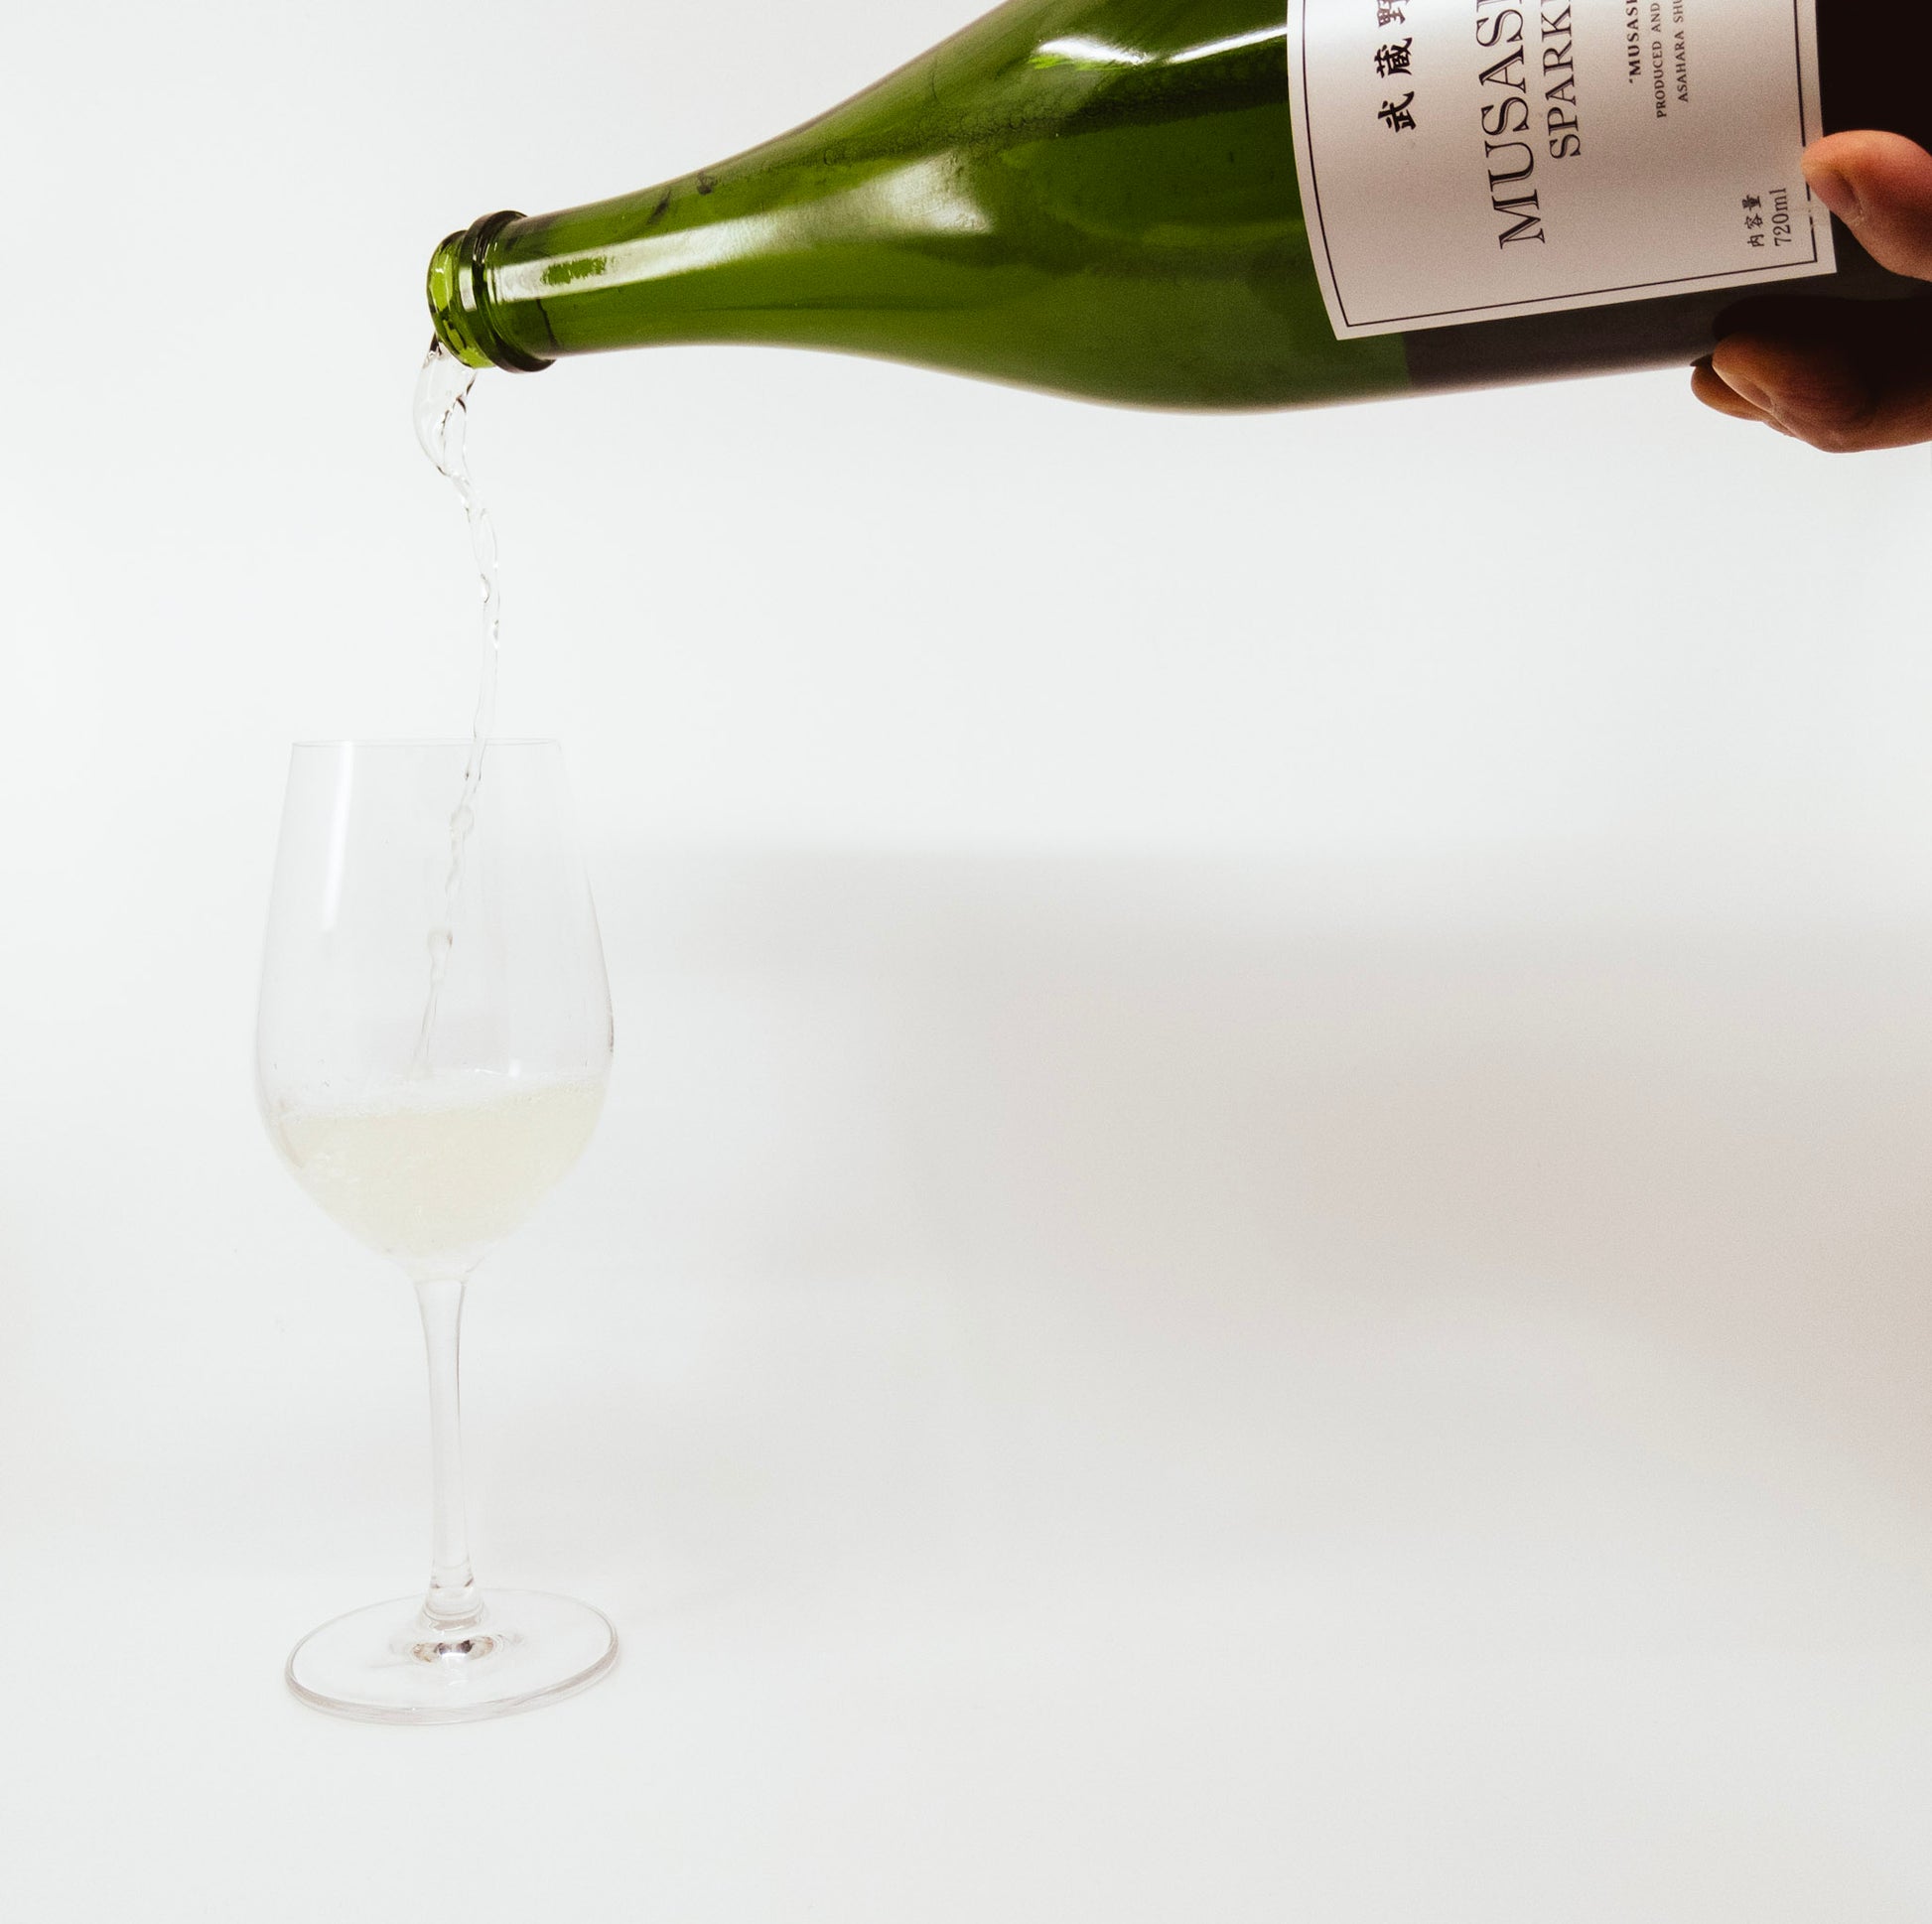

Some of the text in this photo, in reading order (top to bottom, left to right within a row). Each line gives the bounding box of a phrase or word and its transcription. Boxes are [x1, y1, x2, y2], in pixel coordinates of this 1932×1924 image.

[1541, 0, 1581, 159] SPARK
[1650, 3, 1667, 118] PRODUCED AND
[1674, 31, 1689, 103] ASAHARA
[1475, 0, 1546, 249] MUSAS
[1741, 194, 1765, 247] 内容量
[1768, 188, 1792, 247] 720ml
